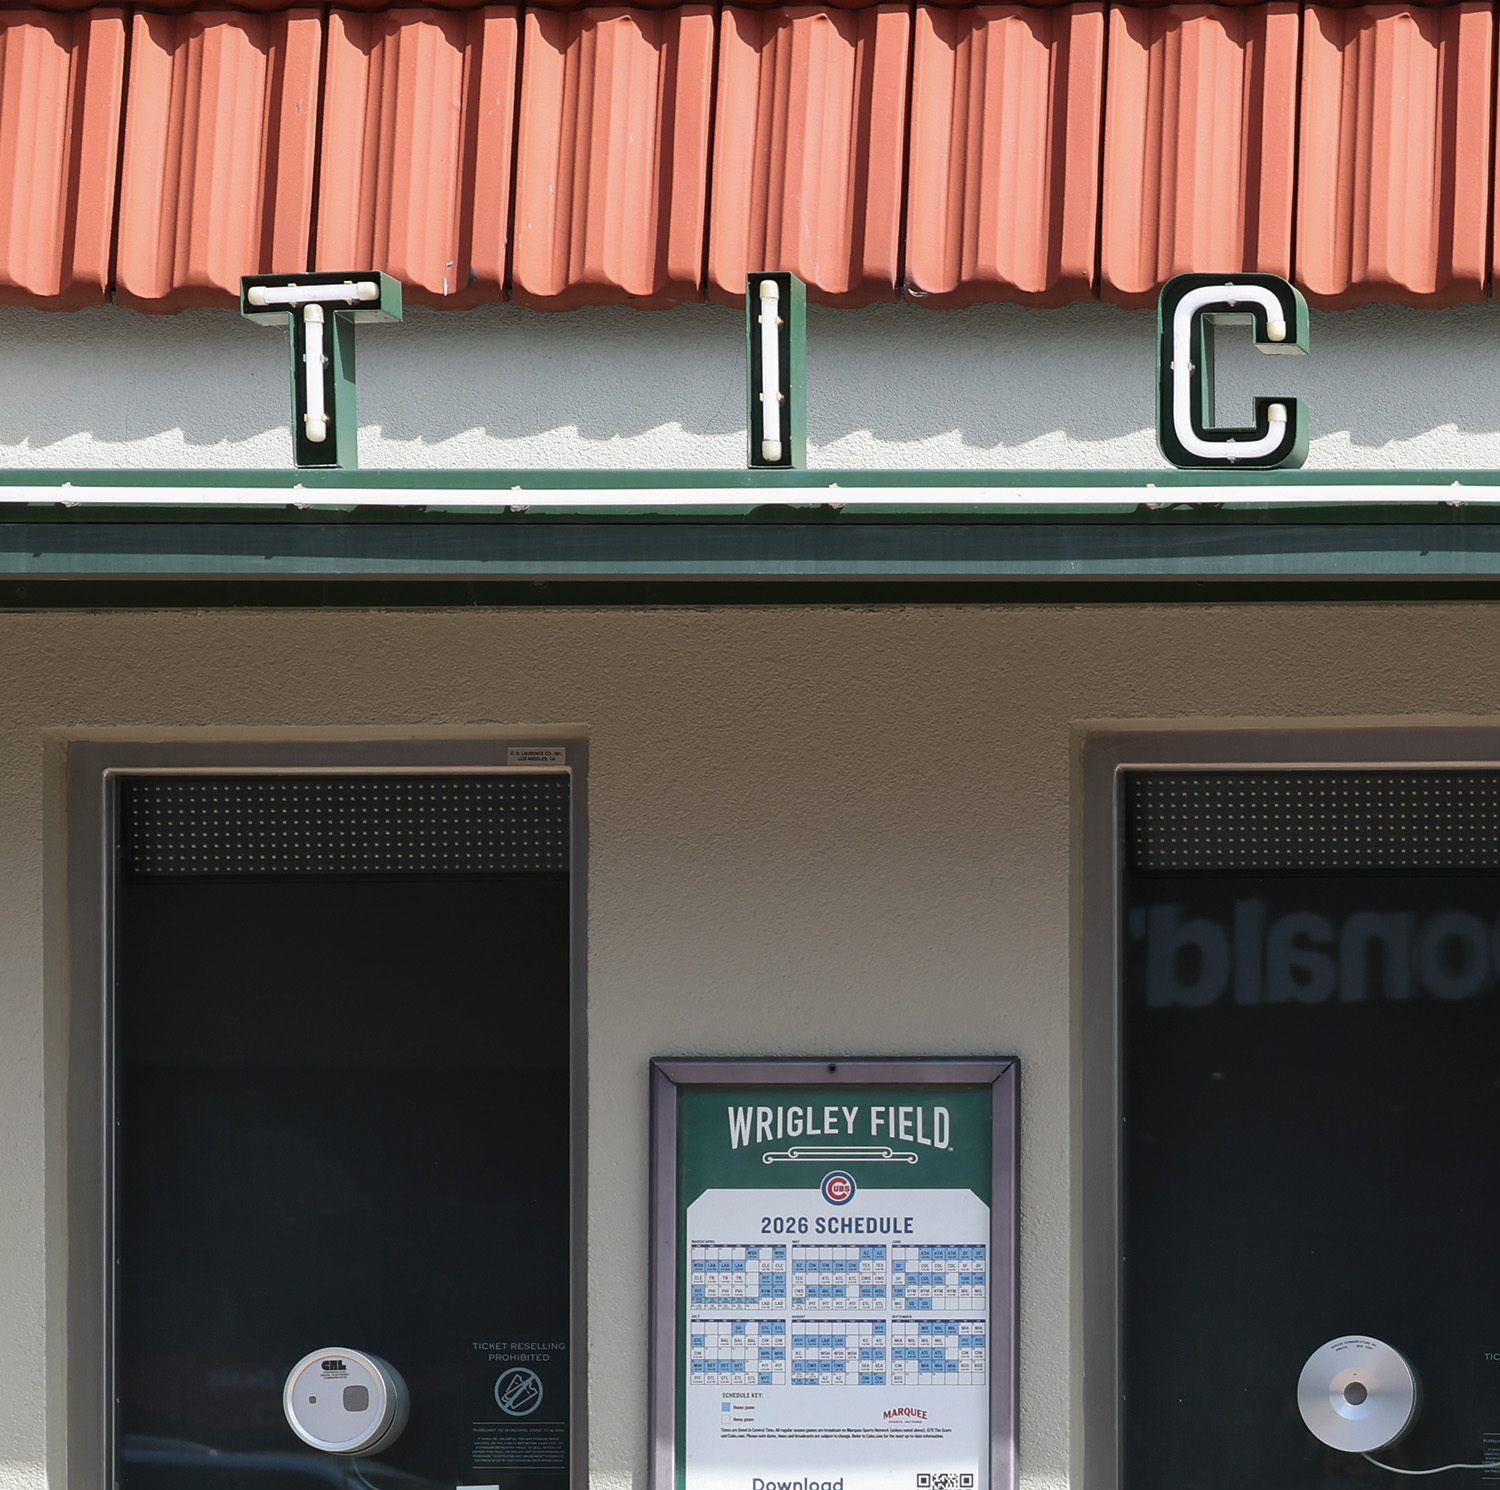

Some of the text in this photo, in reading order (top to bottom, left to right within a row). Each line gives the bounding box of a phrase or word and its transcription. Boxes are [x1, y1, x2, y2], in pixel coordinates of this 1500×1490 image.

[727, 1106, 950, 1150] WRIGLEY FIELD
[762, 1217, 913, 1234] 2026 SCHEDULE
[472, 1342, 566, 1350] TICKET RESELLING
[488, 1353, 550, 1361] PROHIBITED
[883, 1407, 928, 1420] MARQUEE
